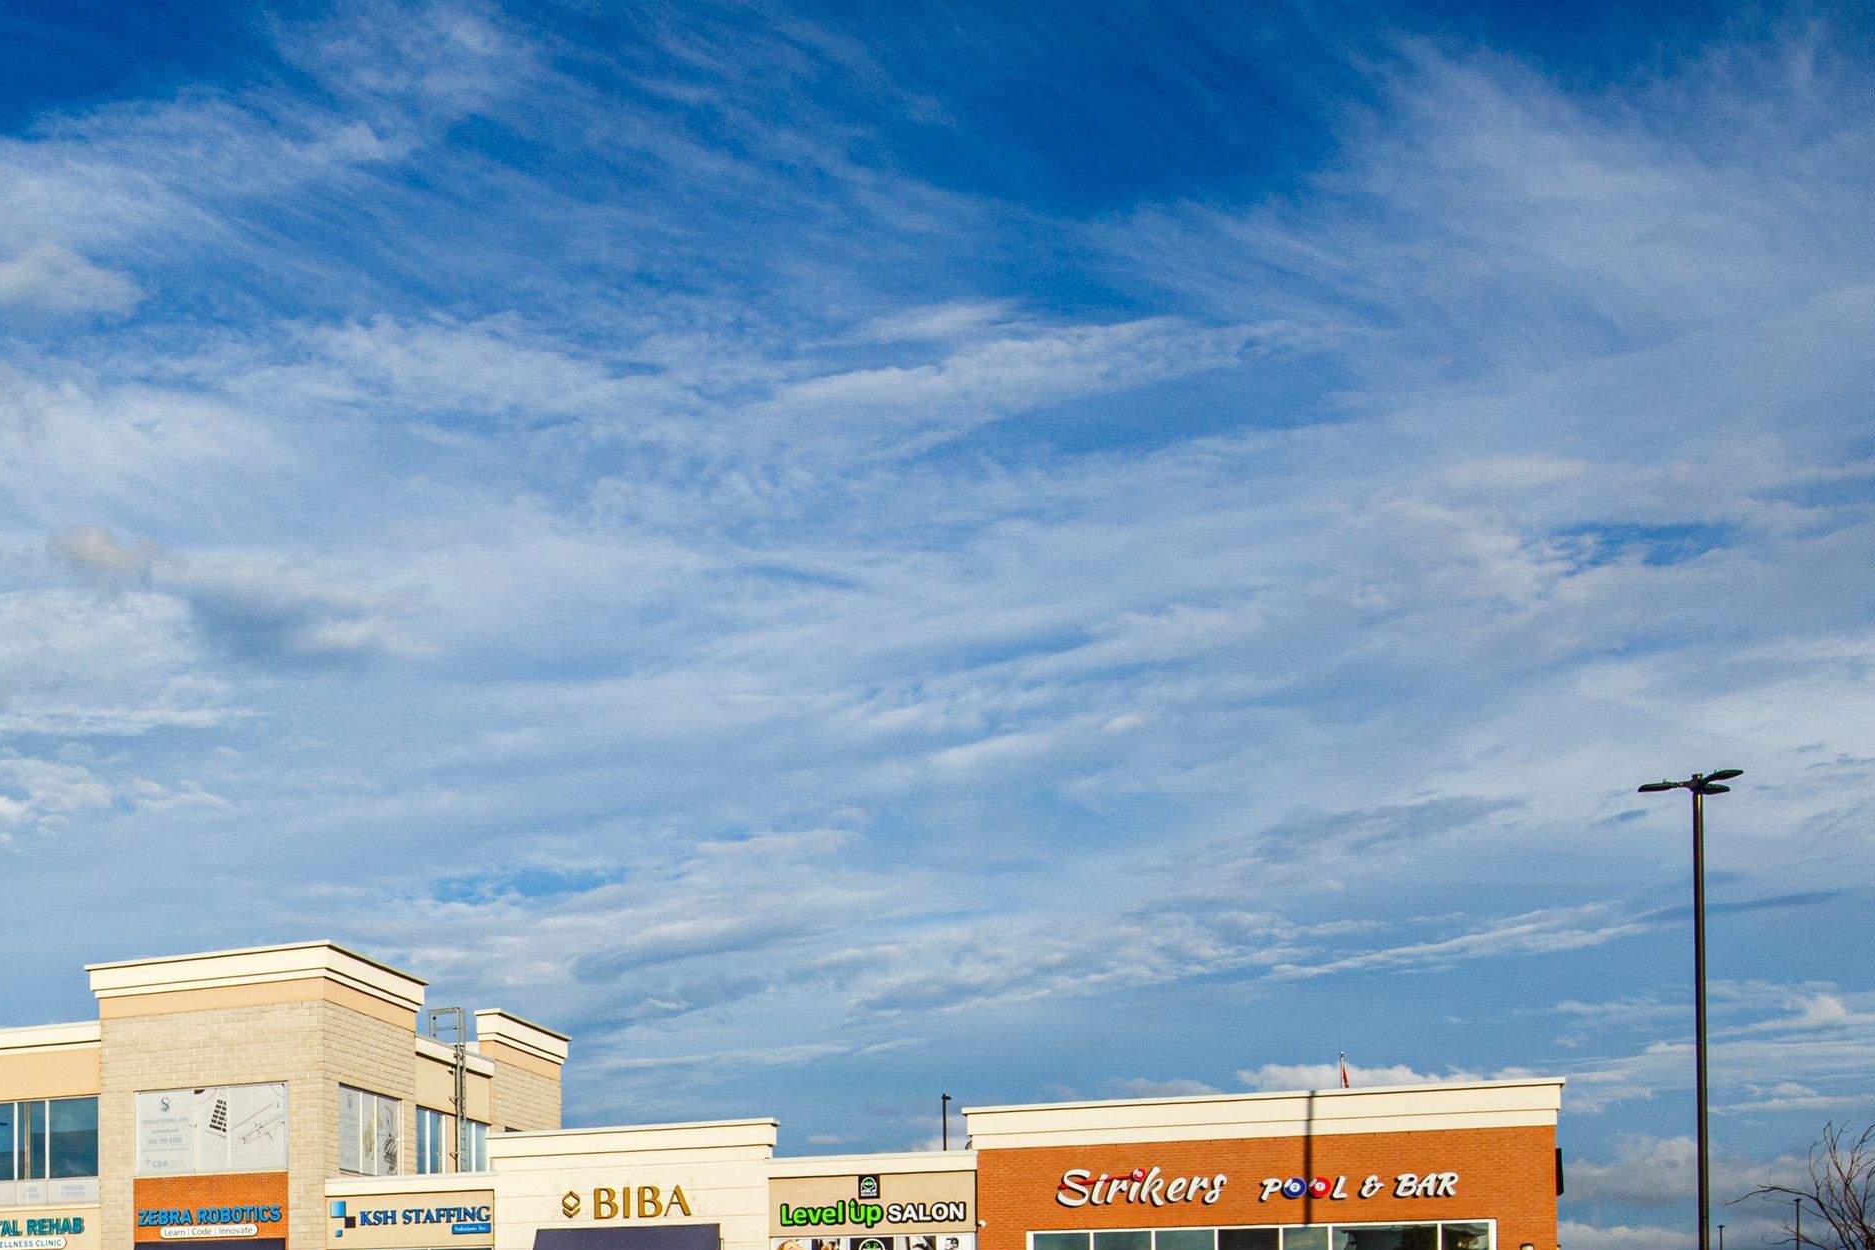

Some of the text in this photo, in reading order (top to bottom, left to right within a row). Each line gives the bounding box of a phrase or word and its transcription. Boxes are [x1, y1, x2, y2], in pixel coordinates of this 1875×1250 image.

[1056, 1166, 1227, 1207] Strikers
[1358, 1174, 1385, 1199] &
[1393, 1172, 1460, 1199] BAR
[594, 1185, 691, 1219] BIBA
[137, 1206, 282, 1226] ZEBRA ROBOTICS
[360, 1206, 491, 1226] KSH STAFFING
[780, 1200, 846, 1226] Level
[887, 1202, 966, 1224] SALON
[26, 1217, 84, 1236] REHAB
[164, 1226, 253, 1237] Learn Code Innovate
[36, 1239, 61, 1248] CLINIC
